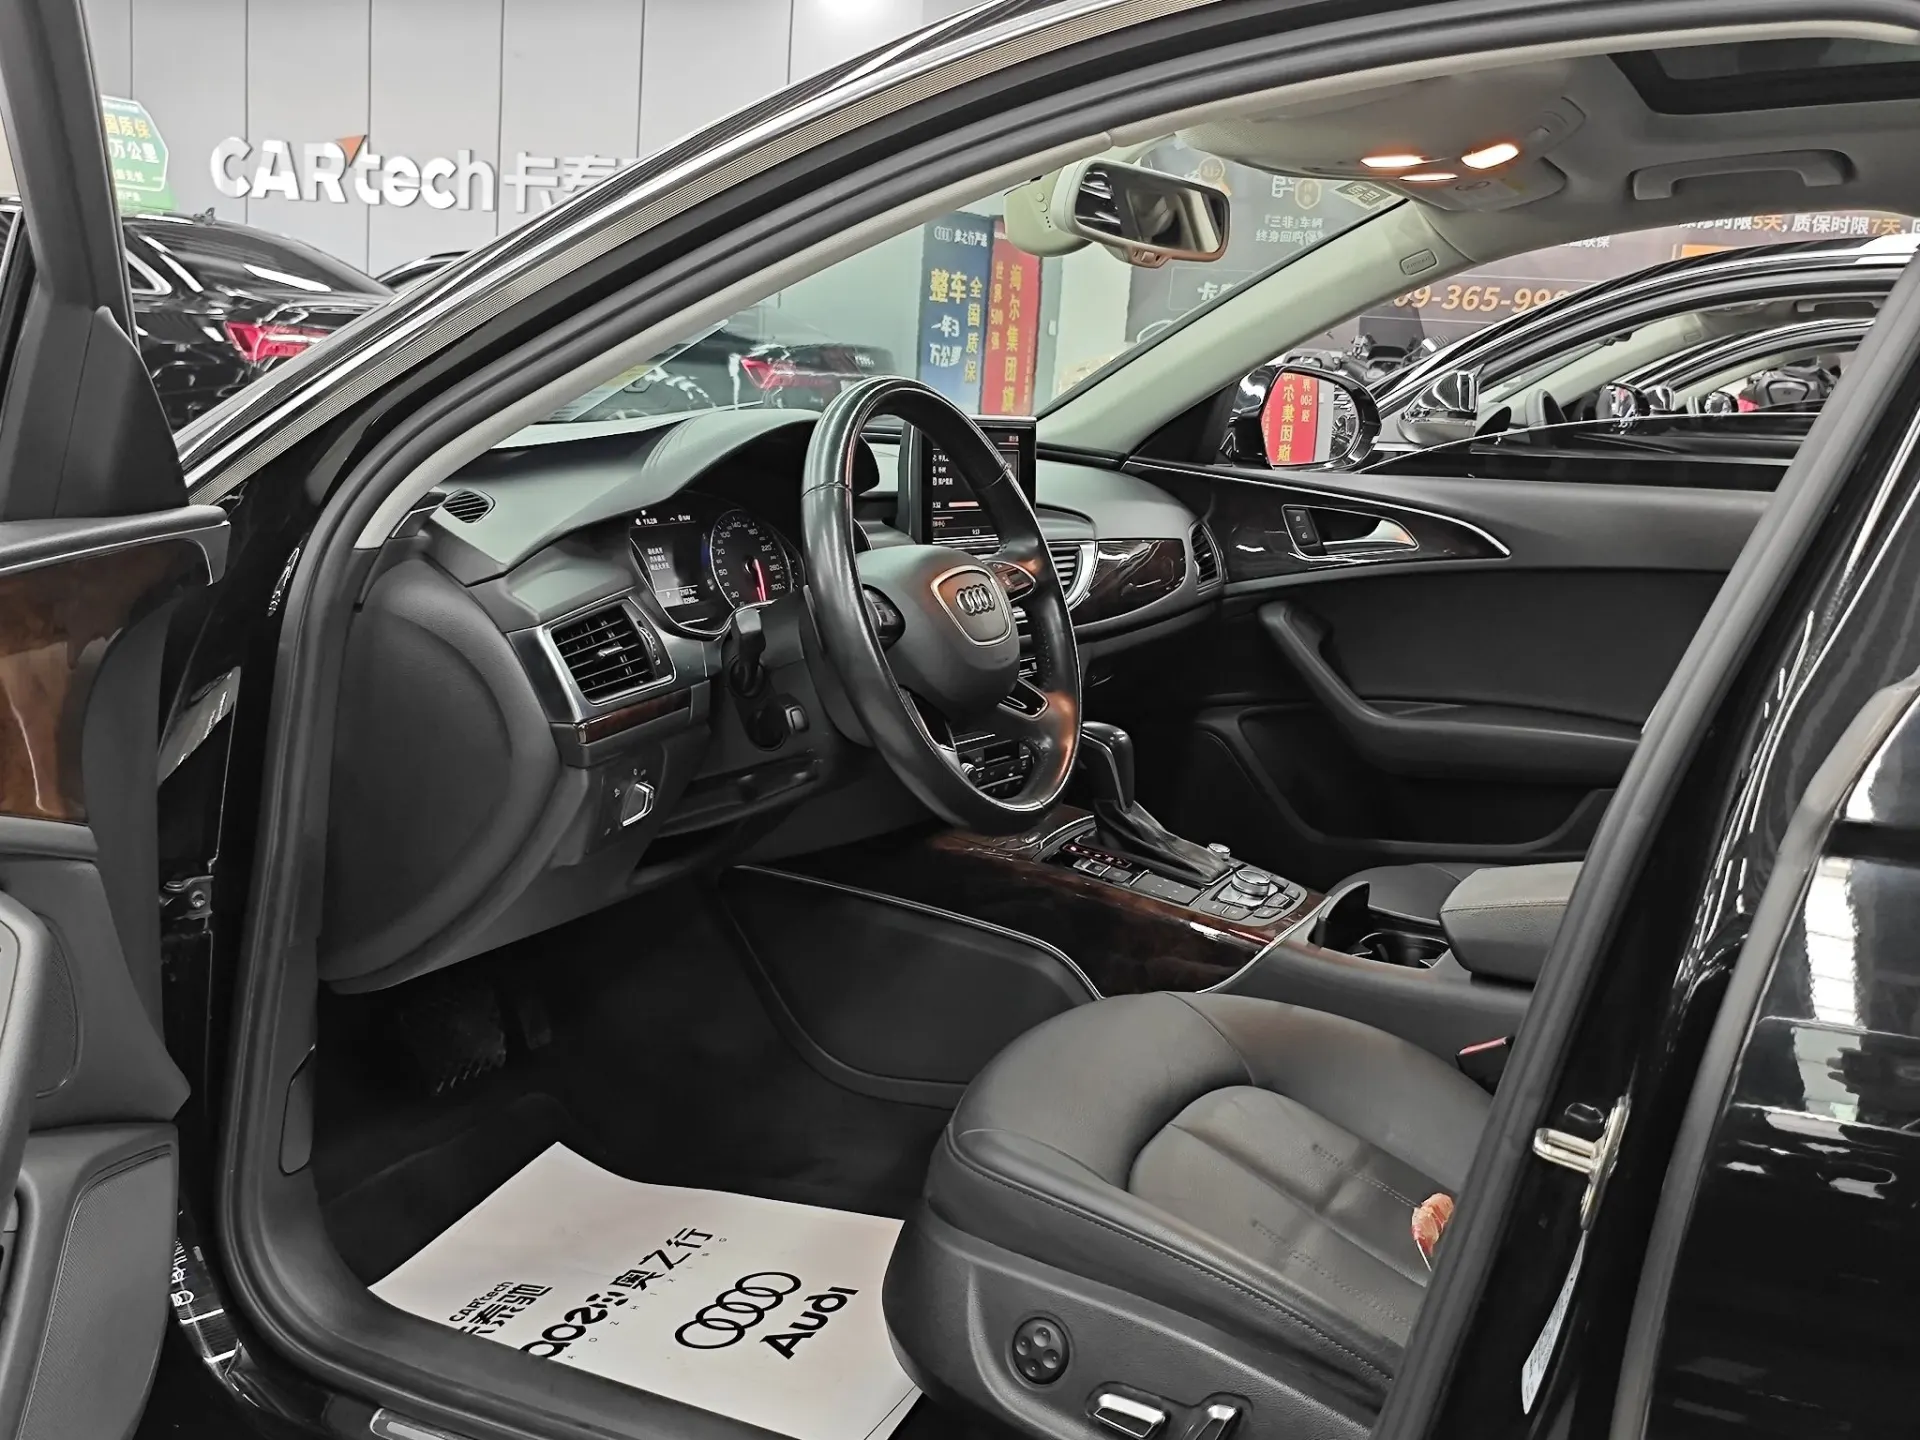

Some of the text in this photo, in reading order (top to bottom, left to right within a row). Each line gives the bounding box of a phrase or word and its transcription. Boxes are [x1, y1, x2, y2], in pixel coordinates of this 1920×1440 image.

[210, 135, 638, 213] CARtech 卡泰
[928, 268, 968, 304] 整车
[609, 1228, 713, 1291] 奥之行
[759, 1286, 860, 1359] Audi
